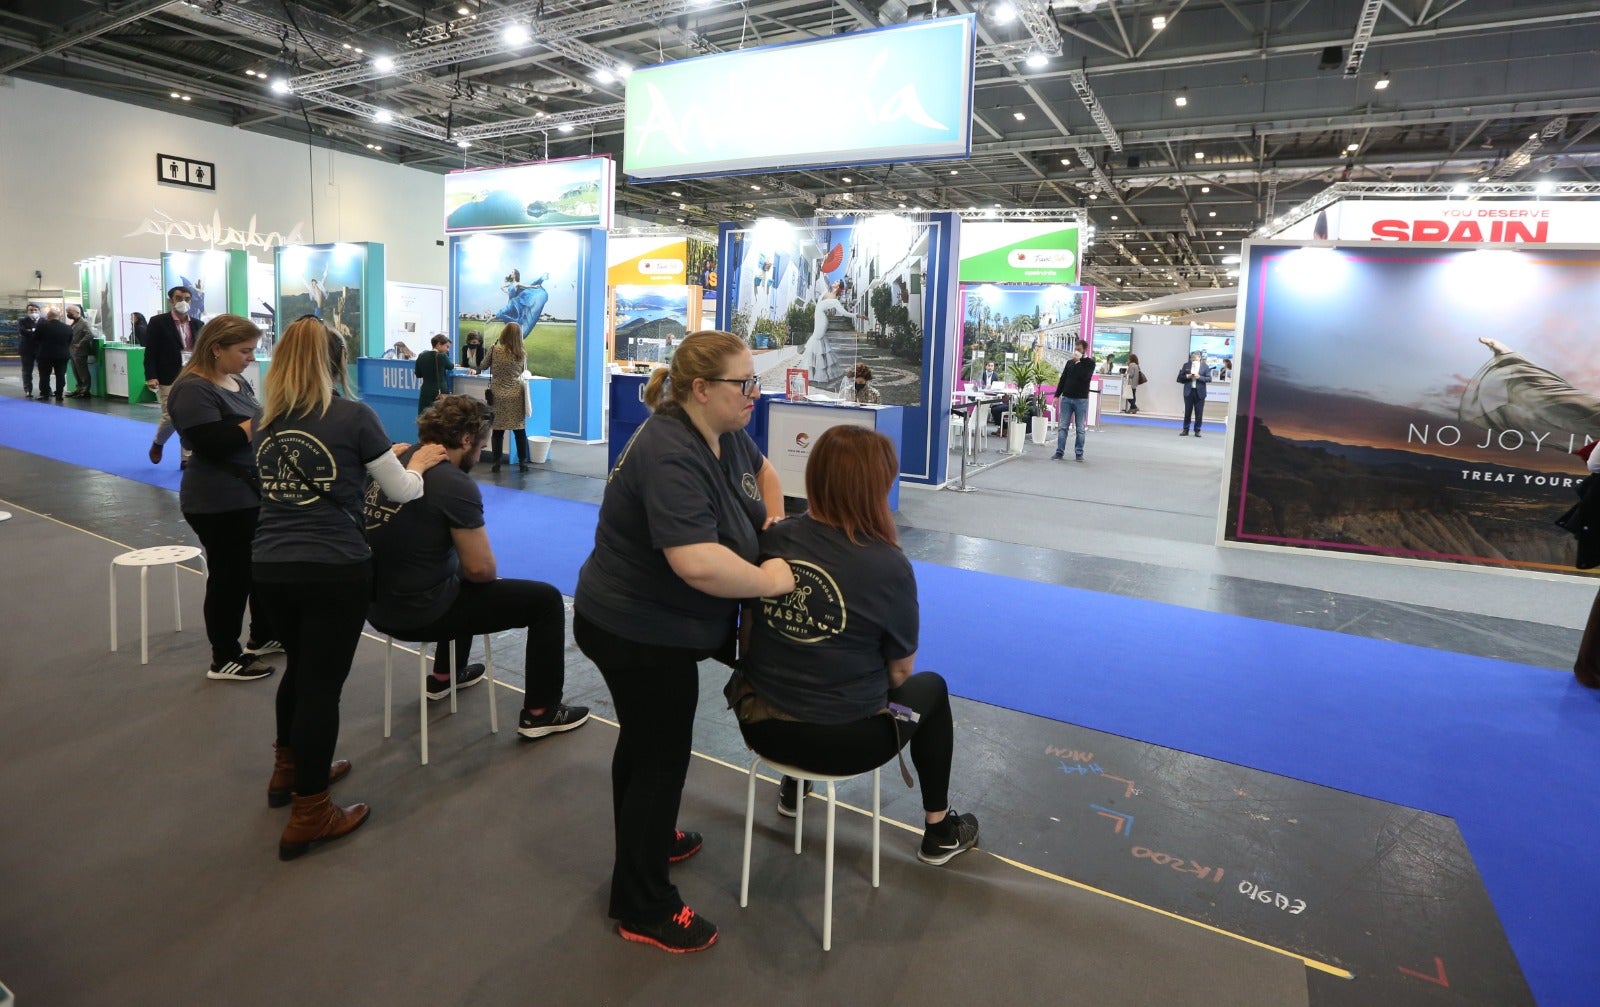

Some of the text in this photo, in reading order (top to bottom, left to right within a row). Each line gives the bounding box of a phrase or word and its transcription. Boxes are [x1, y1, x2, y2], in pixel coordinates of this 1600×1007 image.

[1443, 209, 1550, 218] YOU DESERVE
[1370, 219, 1549, 243] SPAIN
[1407, 423, 1461, 447] NO
[1477, 428, 1550, 452] JOY
[1462, 470, 1515, 483] TREAT
[363, 506, 391, 522] SAGE
